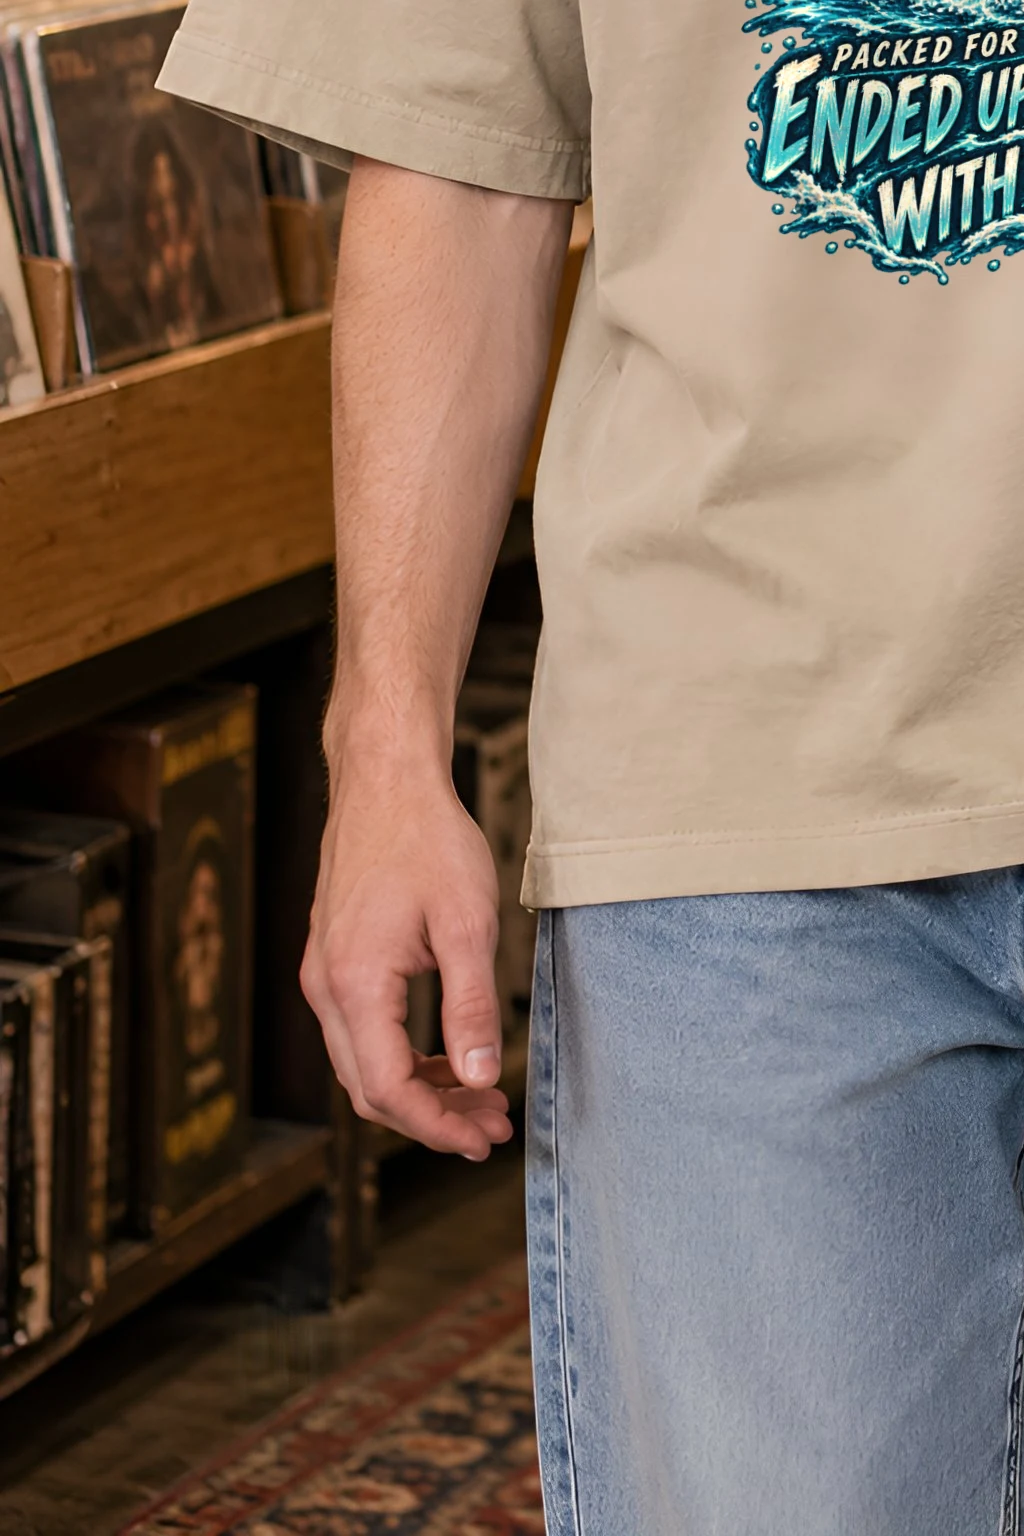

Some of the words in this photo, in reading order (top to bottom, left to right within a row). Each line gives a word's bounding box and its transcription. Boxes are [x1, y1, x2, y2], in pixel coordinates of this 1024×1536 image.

[833, 36, 953, 71] PACKED
[964, 29, 1016, 61] FOR
[763, 54, 962, 182] ENDED
[877, 145, 1020, 251] WITH
